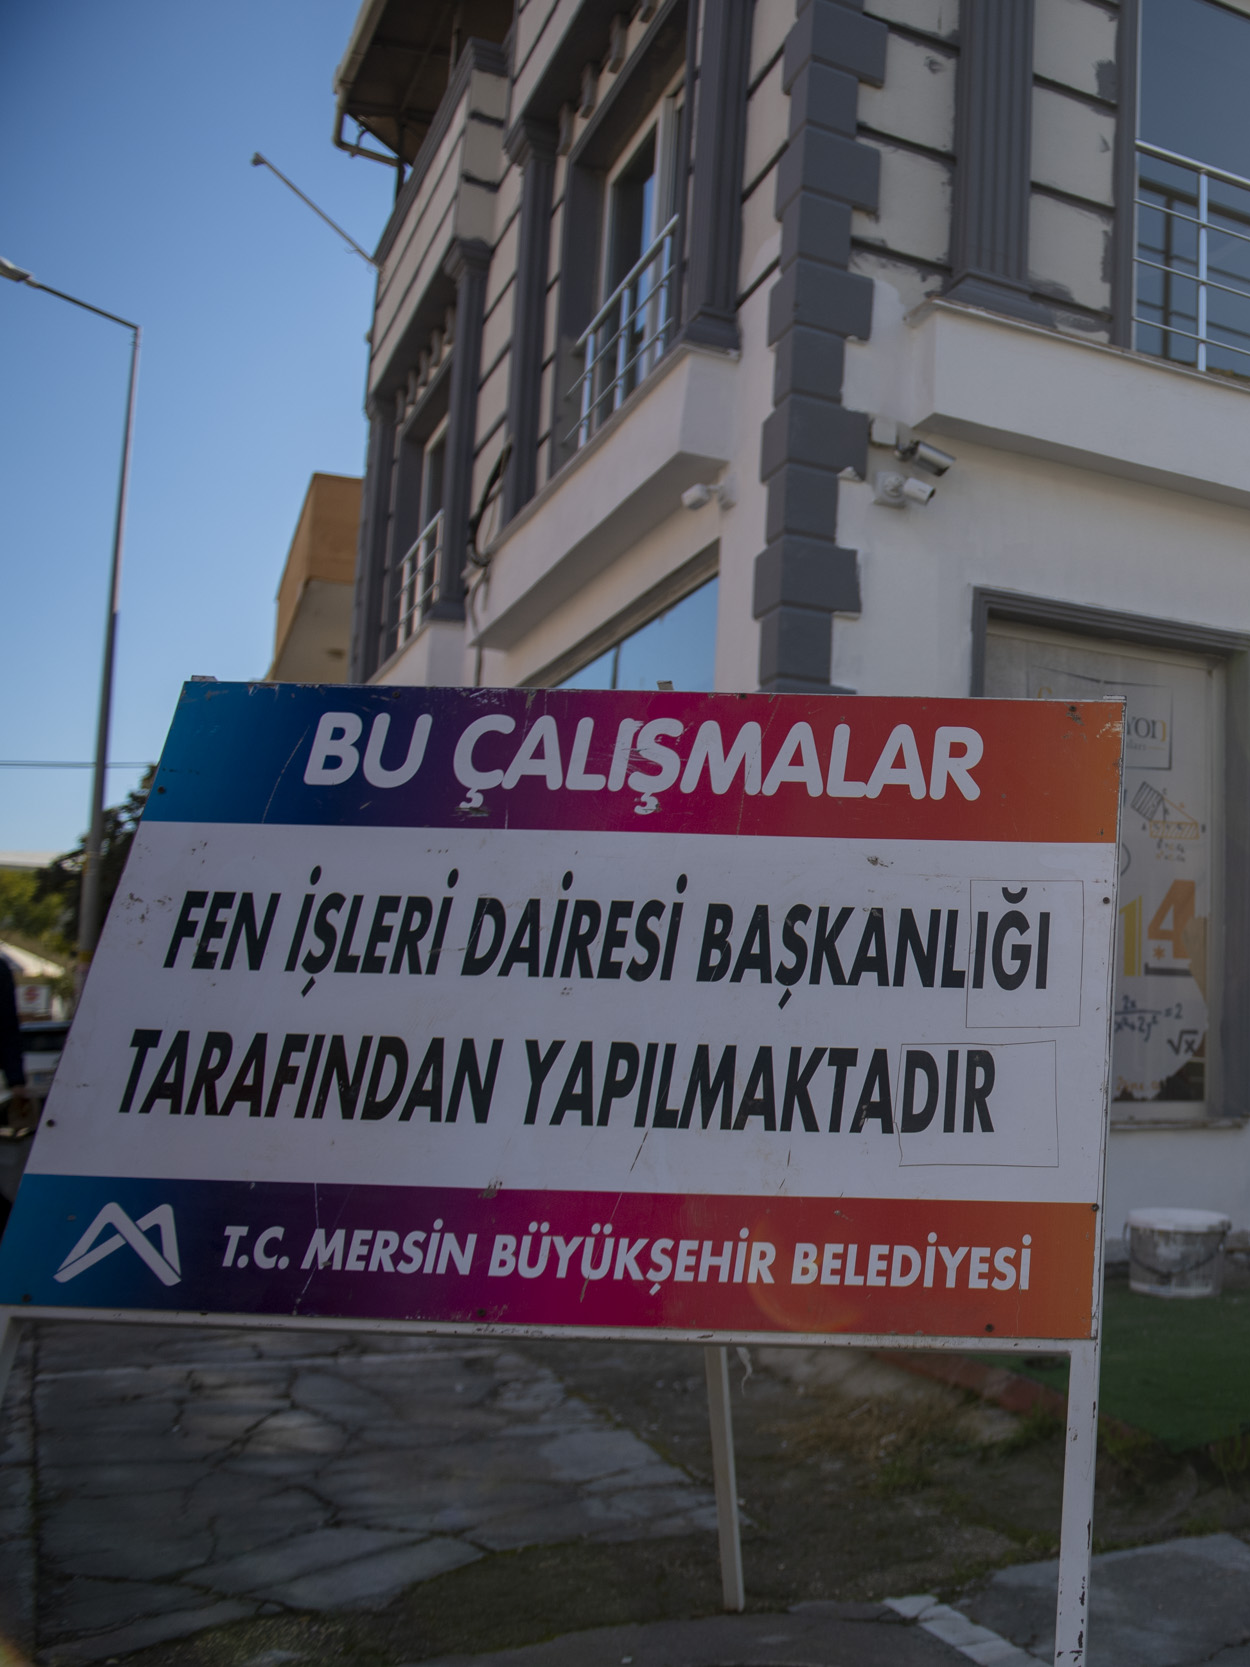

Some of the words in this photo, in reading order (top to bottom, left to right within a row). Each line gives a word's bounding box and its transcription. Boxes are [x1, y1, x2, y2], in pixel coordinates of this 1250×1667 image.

[303, 711, 432, 788] BU
[453, 714, 984, 815] ÇALIŞMALAR
[163, 891, 281, 971] FEN
[284, 865, 459, 998] İŞLERİ
[460, 870, 688, 982] DAİRESİ
[696, 886, 1051, 1009] BAŞKANLIĞI
[118, 1028, 504, 1124] TARAFINDAN
[524, 1039, 996, 1134] YAPILMAKTADIR
[222, 1225, 290, 1271] T.C.
[301, 1218, 477, 1277] MERSİN
[487, 1221, 776, 1296] BÜYÜKŞEHİR
[791, 1231, 1032, 1291] BELEDİYESİ
